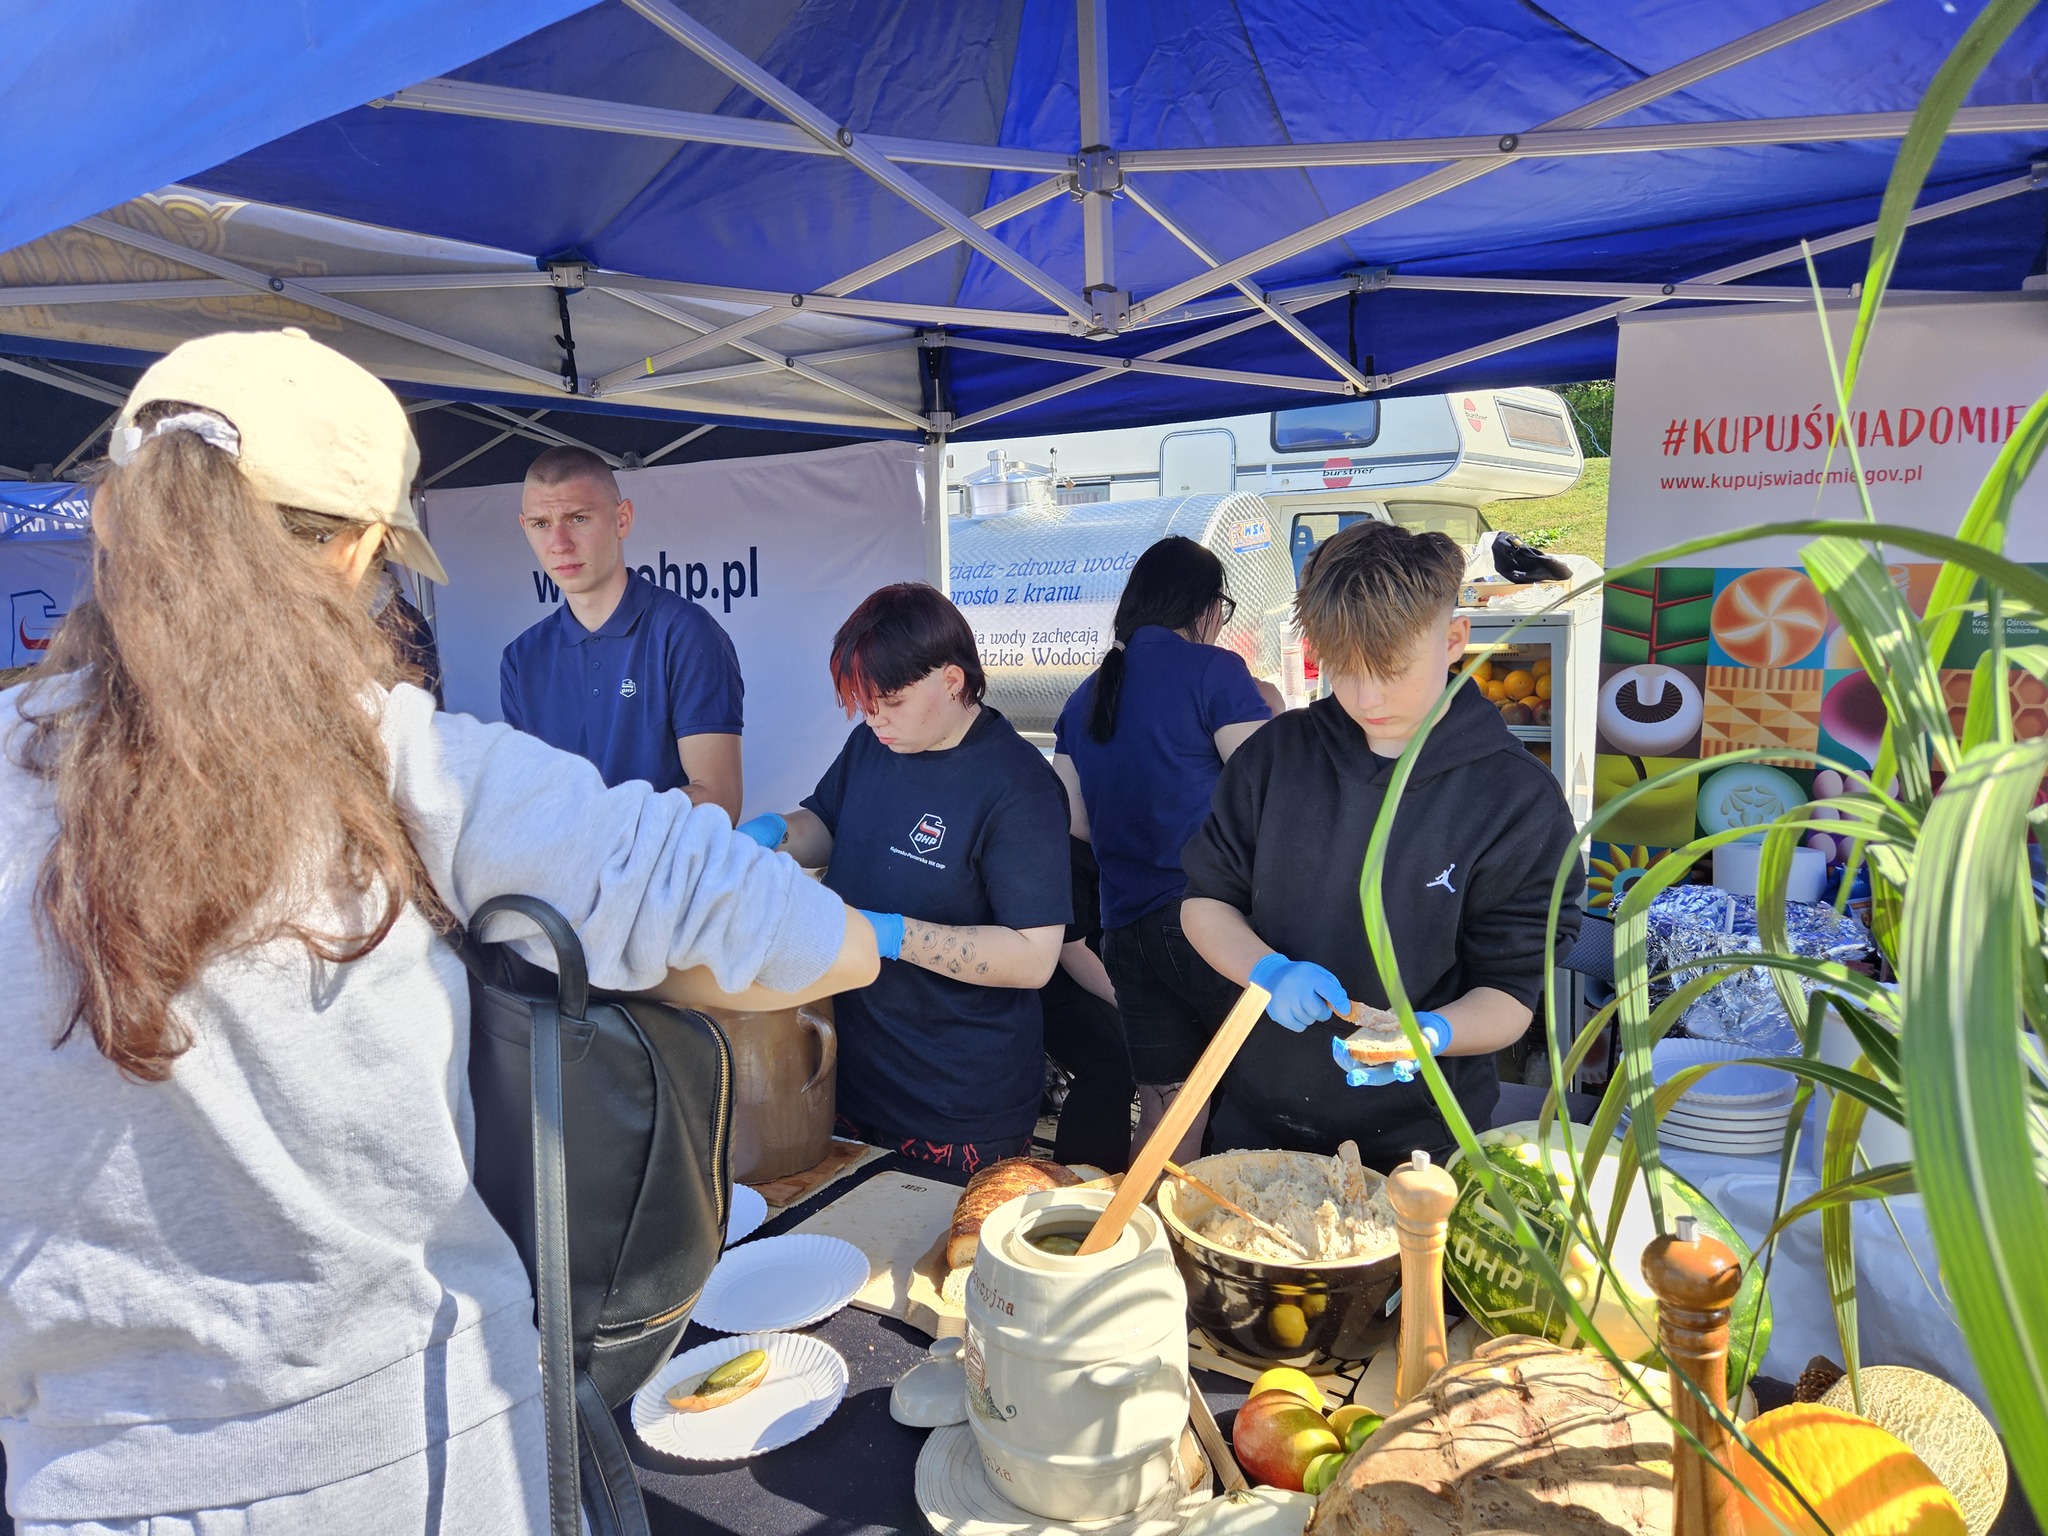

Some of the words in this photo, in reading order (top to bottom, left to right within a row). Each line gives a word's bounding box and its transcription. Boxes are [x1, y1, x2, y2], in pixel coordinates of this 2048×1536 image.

[1660, 465, 1923, 490] www.kupujswiadomiegov.pl
[1083, 551, 1138, 573] woda
[1004, 588, 1017, 604] z
[1023, 583, 1082, 603] kranu
[990, 629, 1026, 648] wody
[1032, 627, 1099, 646] zachęcają
[979, 648, 1024, 667] dzkie
[914, 833, 937, 845] OHP
[1454, 1233, 1523, 1291] OHP
